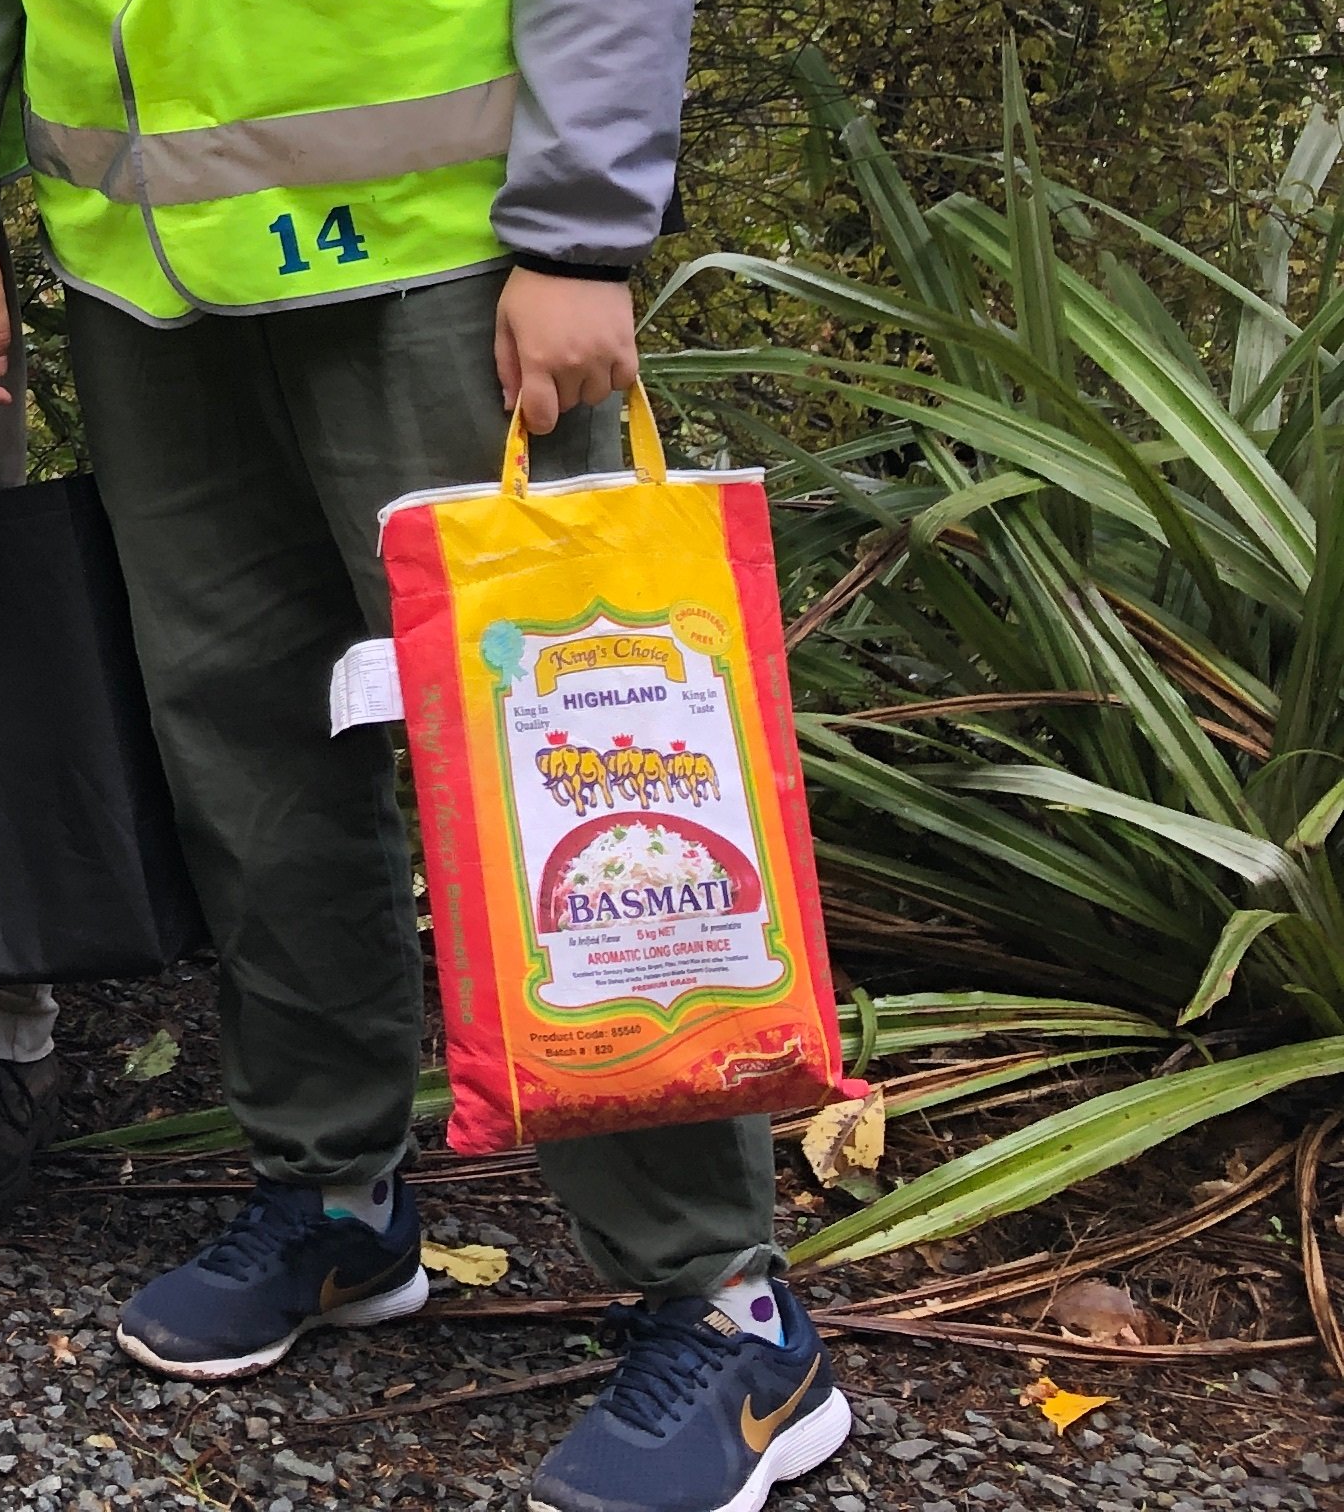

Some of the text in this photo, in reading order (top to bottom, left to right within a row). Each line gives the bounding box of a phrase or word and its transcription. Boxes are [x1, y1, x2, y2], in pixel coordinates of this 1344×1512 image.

[268, 205, 368, 275] 14
[675, 607, 727, 635] CHOLESTEROL
[690, 631, 714, 645] FREE
[550, 638, 668, 669] King's Choice
[563, 686, 667, 710] HIGHLAND
[682, 689, 717, 701] King in
[513, 705, 548, 718] King in
[689, 704, 714, 714] Taste
[515, 719, 550, 732] Quality
[568, 880, 731, 924] BASMATI
[637, 925, 676, 940] 5 kg NET
[588, 938, 731, 965] AROMATIC LONG GRAIN RICE
[632, 977, 697, 992] PREMIUM GRADE
[530, 1032, 573, 1042] Product
[576, 1030, 608, 1040] Code:
[545, 1047, 577, 1057] Batch
